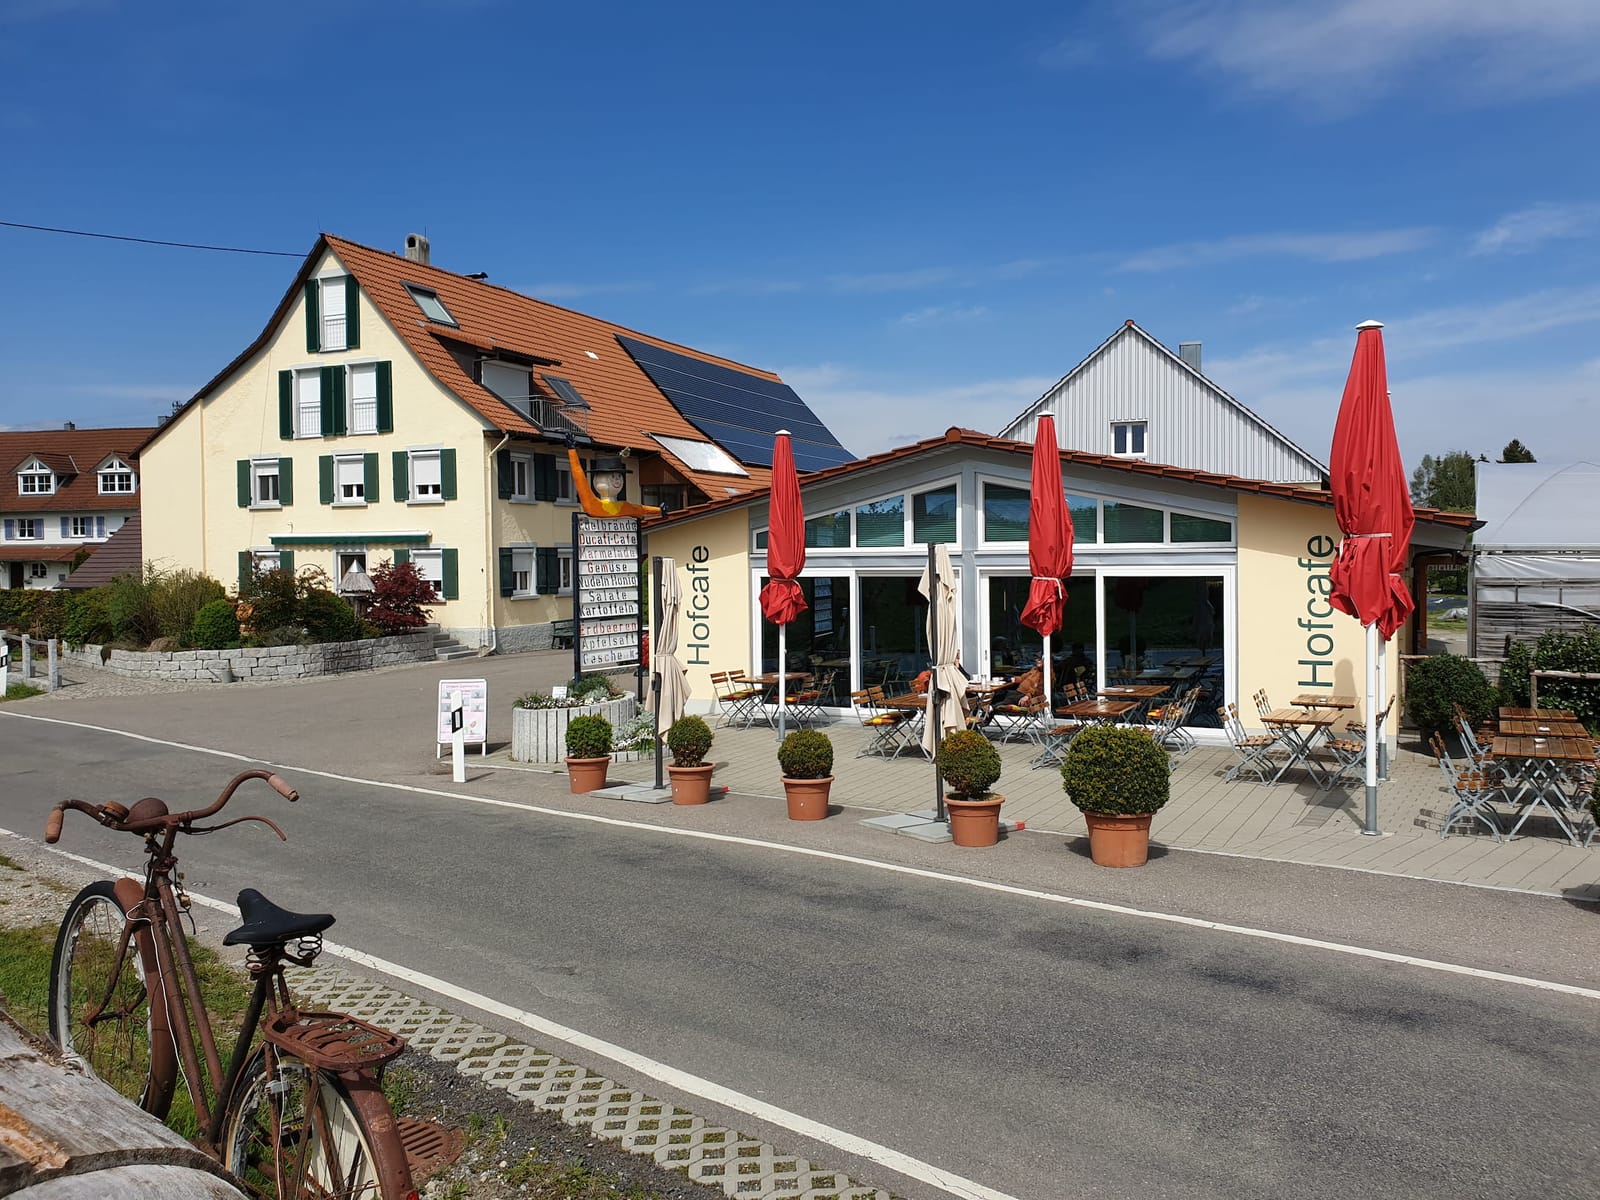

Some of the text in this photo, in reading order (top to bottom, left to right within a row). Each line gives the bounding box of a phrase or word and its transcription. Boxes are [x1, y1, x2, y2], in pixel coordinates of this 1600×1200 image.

[587, 560, 628, 573] Gemüse
[611, 574, 637, 587] Honig
[588, 589, 627, 602] Salate
[686, 545, 710, 665] Hofcafe
[1298, 534, 1334, 687] Hofcafe
[579, 622, 637, 635] Erdbeeren
[582, 632, 635, 650] Apfelsaft
